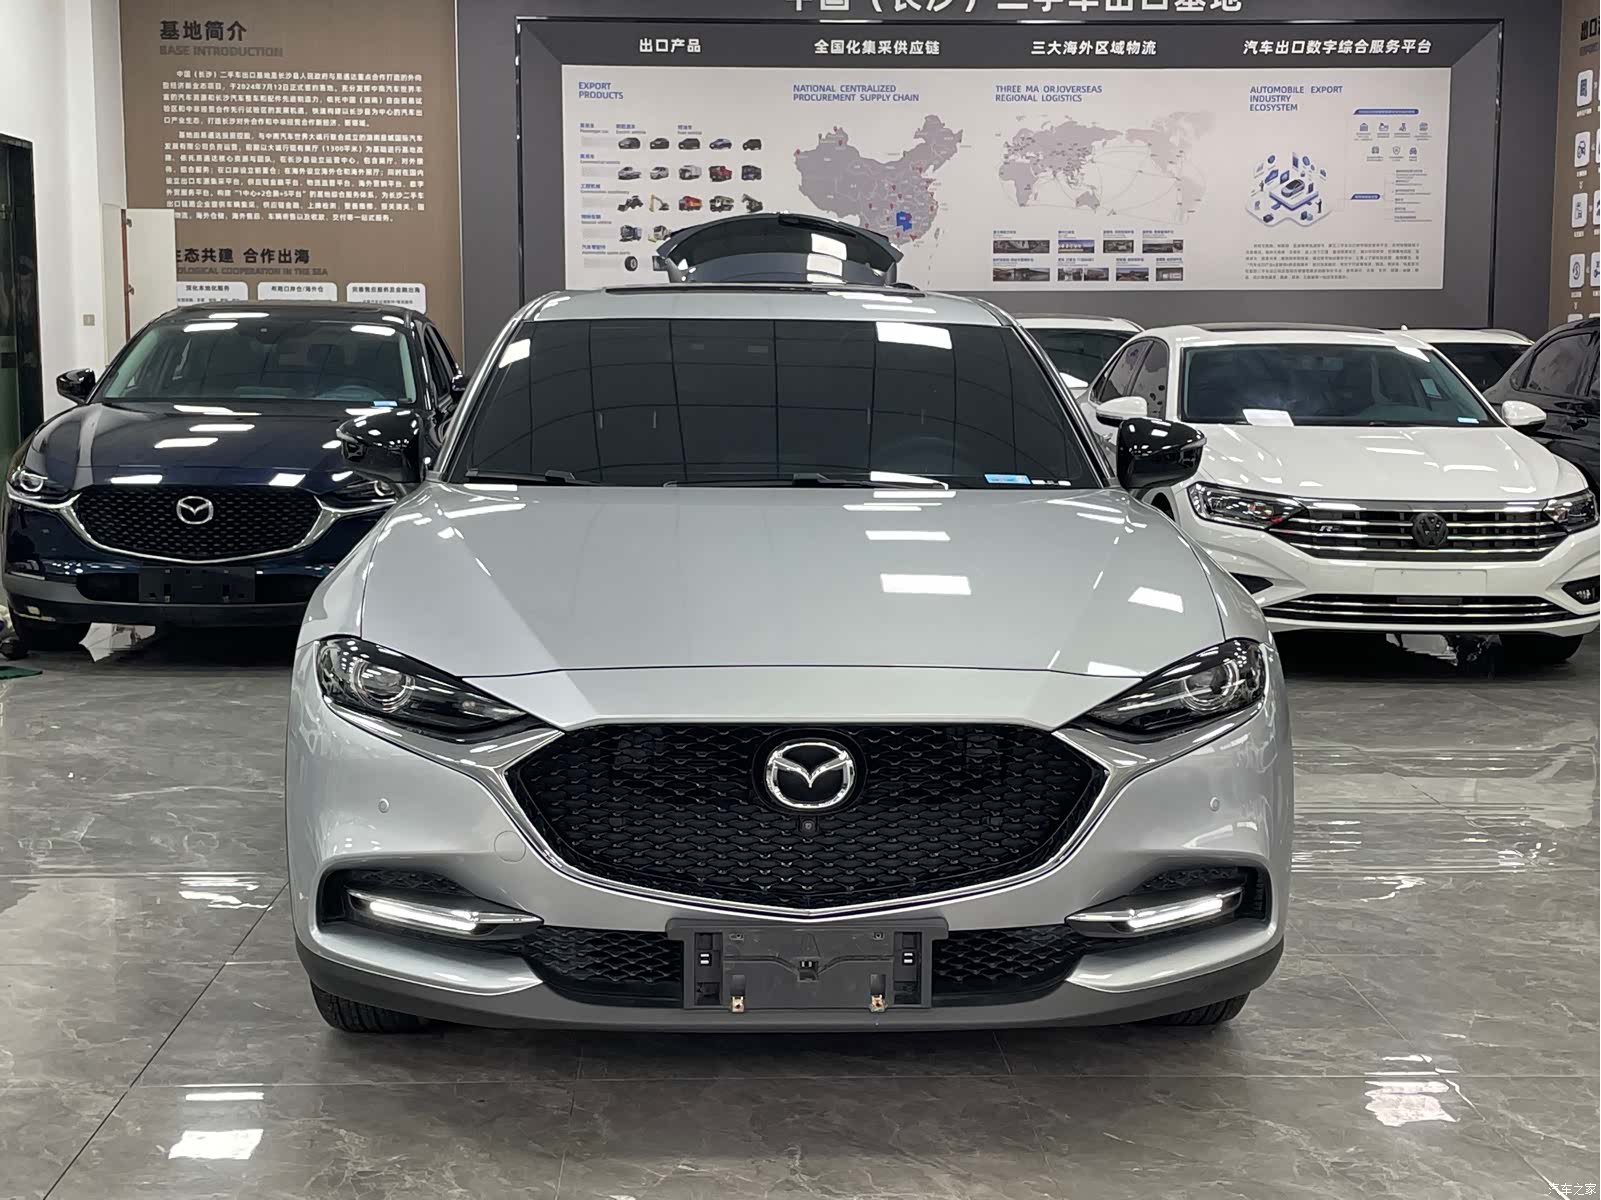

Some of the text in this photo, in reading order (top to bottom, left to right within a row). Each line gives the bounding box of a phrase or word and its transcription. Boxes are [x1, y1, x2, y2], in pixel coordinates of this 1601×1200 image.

[160, 20, 247, 41] 基地简介
[639, 38, 701, 53] 出口产品
[814, 39, 940, 55] 全国化集采供应链
[1031, 40, 1157, 55] 三大海外区域物流
[1243, 38, 1432, 55] 汽车出口数字综合服务平台
[160, 45, 283, 57] BASE INTRODUCTION
[579, 81, 611, 90] EXPORT
[793, 84, 896, 93] NATIONAL CENTRALIZED
[996, 85, 1022, 93] THREE
[1025, 85, 1039, 93] MA
[1250, 86, 1343, 94] AUTOMOBILE EXPORT
[579, 91, 624, 100] PRODUCTS
[793, 93, 919, 102] PROCUREMENT SUPPLY CHAIN
[995, 94, 1082, 102] REGIONAL LOGISTICS
[1250, 95, 1291, 103] INDUSTRY
[1250, 104, 1298, 112] ECOSYSTEM
[243, 248, 310, 264] 合作出海
[177, 267, 218, 275] OLOGICAL
